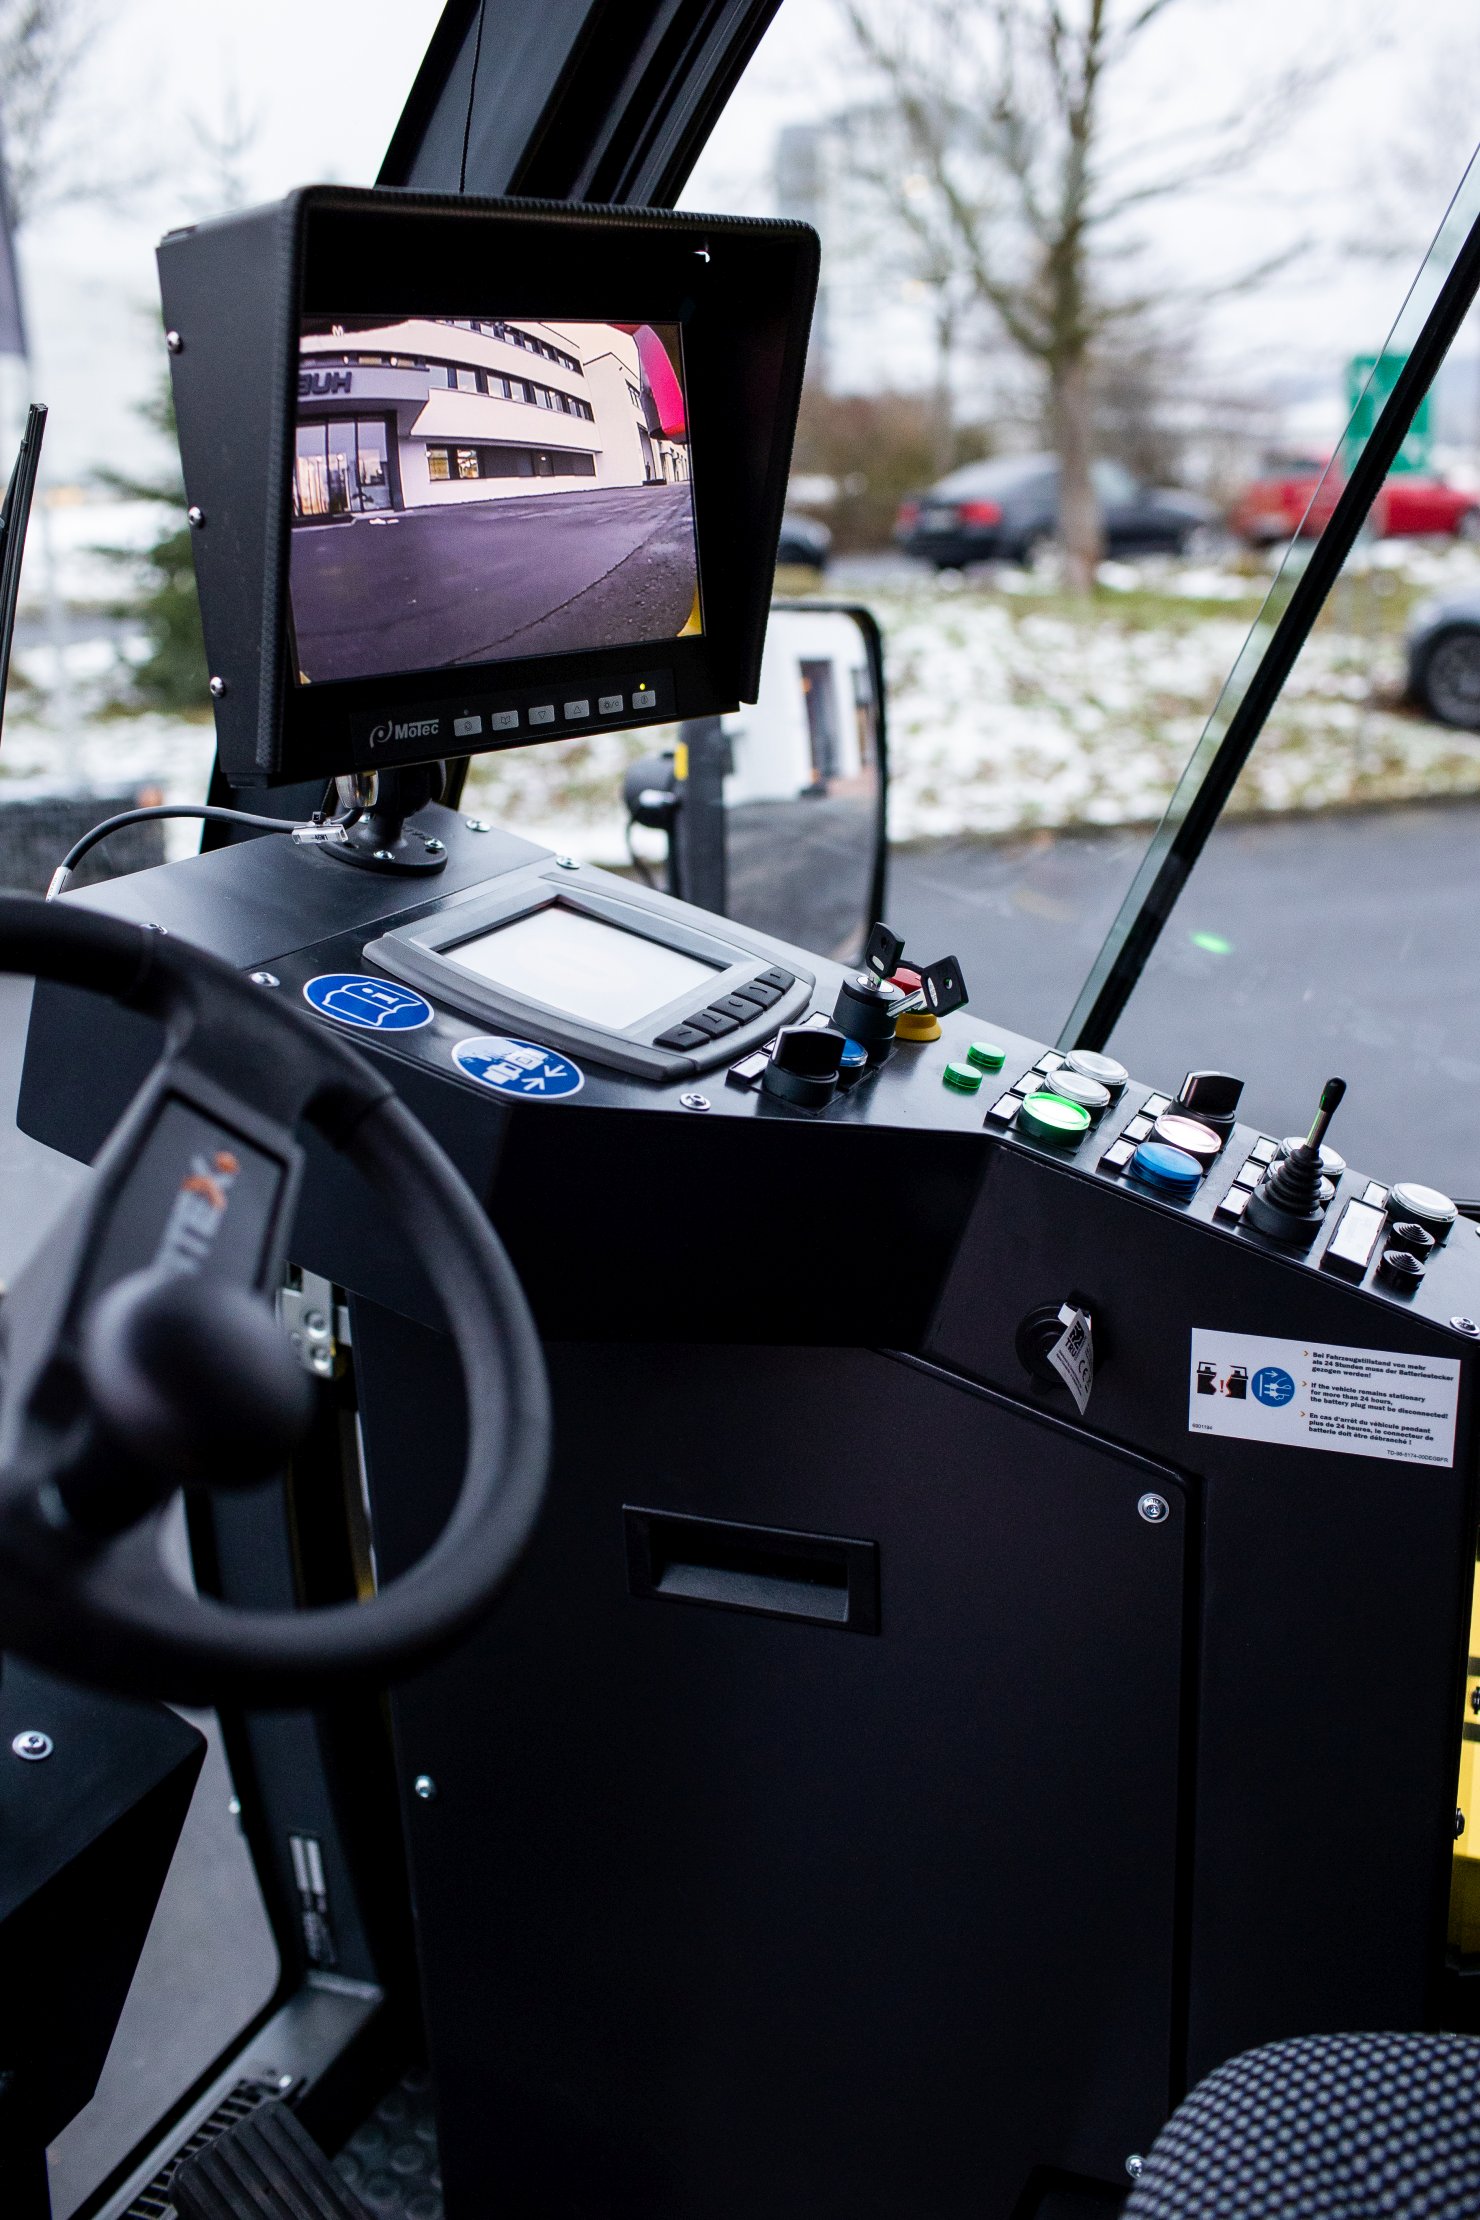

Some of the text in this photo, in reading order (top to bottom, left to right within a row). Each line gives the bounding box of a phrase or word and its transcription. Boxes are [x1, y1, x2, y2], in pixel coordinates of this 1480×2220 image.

[1326, 1354, 1391, 1367] Fahrzeugstillstand
[1407, 1363, 1426, 1371] mehr
[1334, 1361, 1364, 1371] Stunden
[1398, 1369, 1454, 1381] Batteriestecker
[1311, 1366, 1372, 1379] gezogen werden!
[1331, 1385, 1357, 1394] vehicle
[1358, 1389, 1387, 1398] remains
[1388, 1393, 1426, 1403] stationary
[1342, 1393, 1359, 1401] than
[1370, 1397, 1393, 1406] hours,
[1323, 1398, 1349, 1407] battery
[1350, 1402, 1366, 1410] plug
[1397, 1407, 1449, 1419] disconnected!
[1333, 1416, 1358, 1424] d'arrêt
[1369, 1421, 1400, 1430] véhicule
[1400, 1425, 1431, 1434] pendant
[1346, 1424, 1373, 1434] heures,
[1383, 1430, 1424, 1440] connecteur
[1308, 1426, 1337, 1435] batterie
[1337, 1430, 1352, 1438] doit
[1353, 1432, 1368, 1440] être
[1369, 1434, 1408, 1445] débranché
